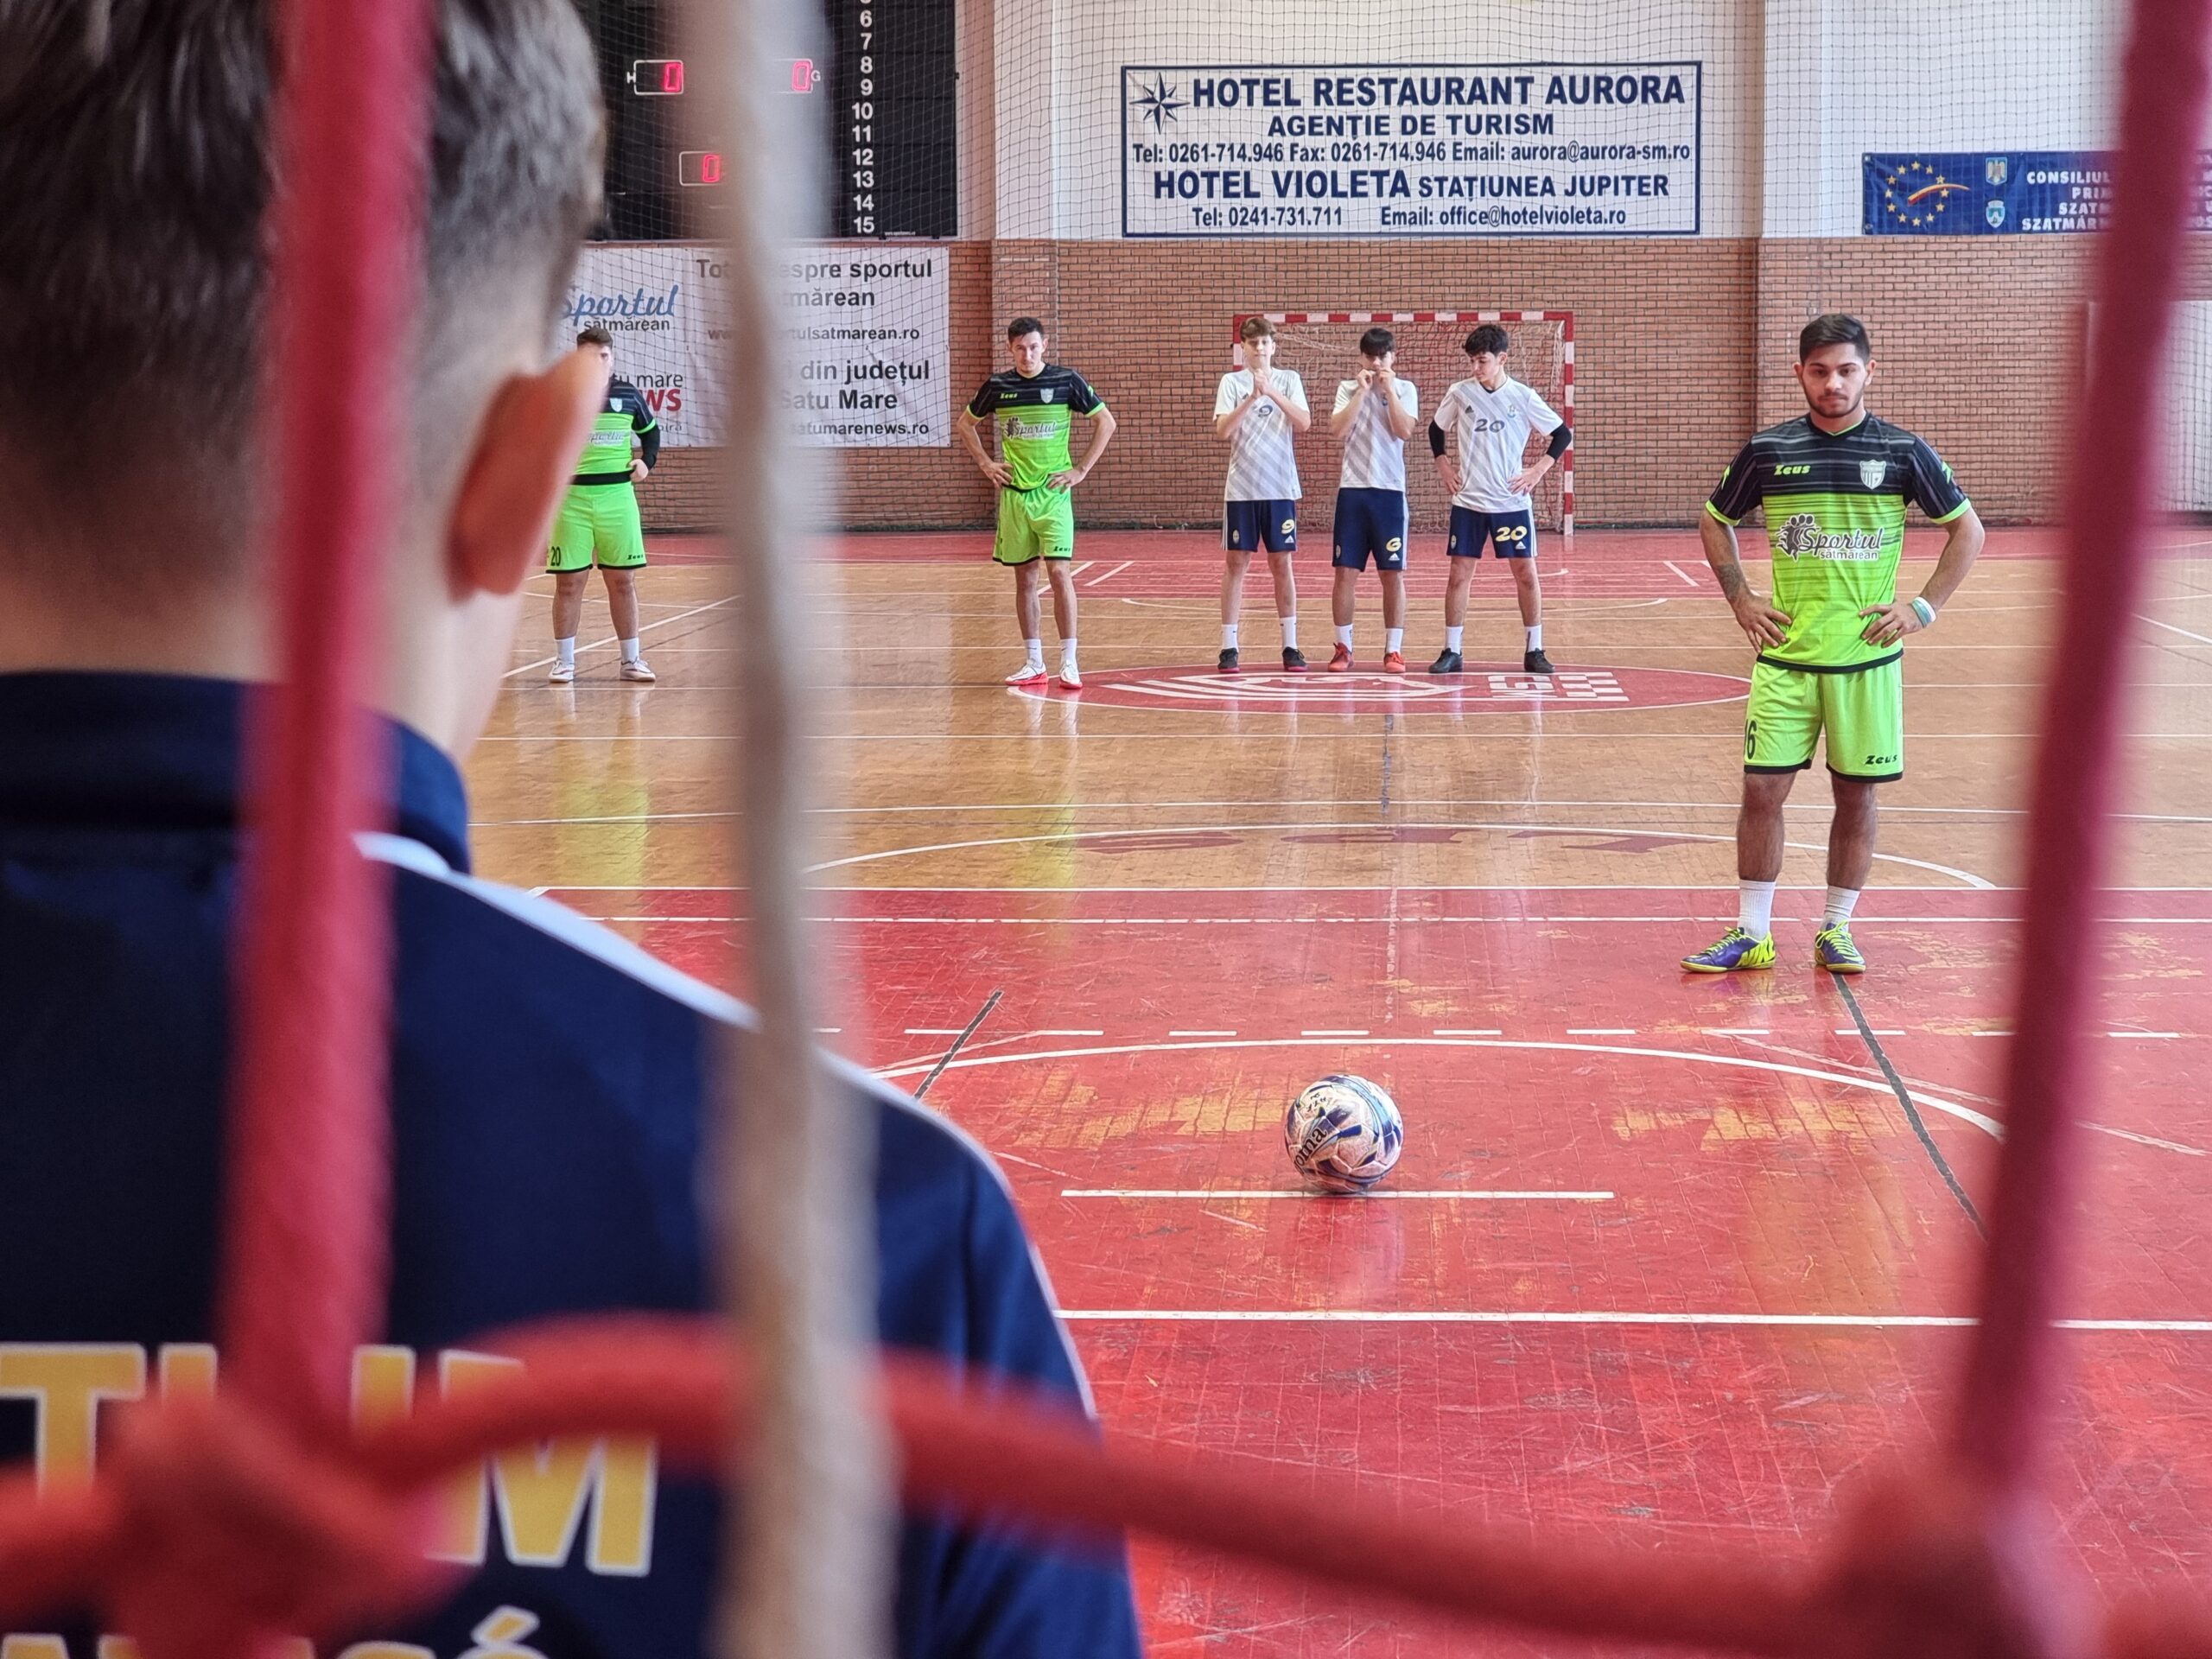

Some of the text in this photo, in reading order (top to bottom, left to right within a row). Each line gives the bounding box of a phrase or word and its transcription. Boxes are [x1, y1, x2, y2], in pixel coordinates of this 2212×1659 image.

[860, 10, 873, 28] 6
[861, 33, 873, 50] 7
[860, 56, 873, 74] 8
[861, 79, 874, 96] 9
[1193, 74, 1685, 107] HOTEL RESTAURANT AURORA
[852, 102, 874, 120] 10
[852, 124, 872, 143] 11
[1401, 114, 1436, 136] DE
[1446, 113, 1554, 136] TURISM
[852, 148, 874, 166] 12
[1133, 140, 1691, 163] Tel: 0261-714.946 Fax: 0261-714.946 Email: aurora@aurora-sm.ro
[853, 171, 874, 188] 13
[1154, 170, 1262, 199] HOTEL
[1271, 169, 1411, 199] VIOLETA
[1564, 174, 1670, 197] JUPITER
[853, 194, 874, 212] 14
[853, 216, 874, 233] 15
[1192, 206, 1343, 226] Tel: 0241-731.711
[1381, 205, 1627, 227] Email: office@hotelvioleta.ro
[776, 261, 842, 283] espre
[849, 258, 933, 283] sportul
[786, 287, 875, 307] mărean
[636, 373, 684, 388] mare
[799, 360, 838, 379] din
[844, 359, 930, 386] județul
[838, 389, 899, 410] Mare
[1474, 418, 1506, 433] 20
[1774, 464, 1812, 476] Zeus
[1281, 519, 1295, 535] 9
[1496, 525, 1528, 543] 20
[1799, 525, 1884, 557] Sportul
[1865, 753, 1898, 765] Zeus
[1294, 1126, 1329, 1168] oma
